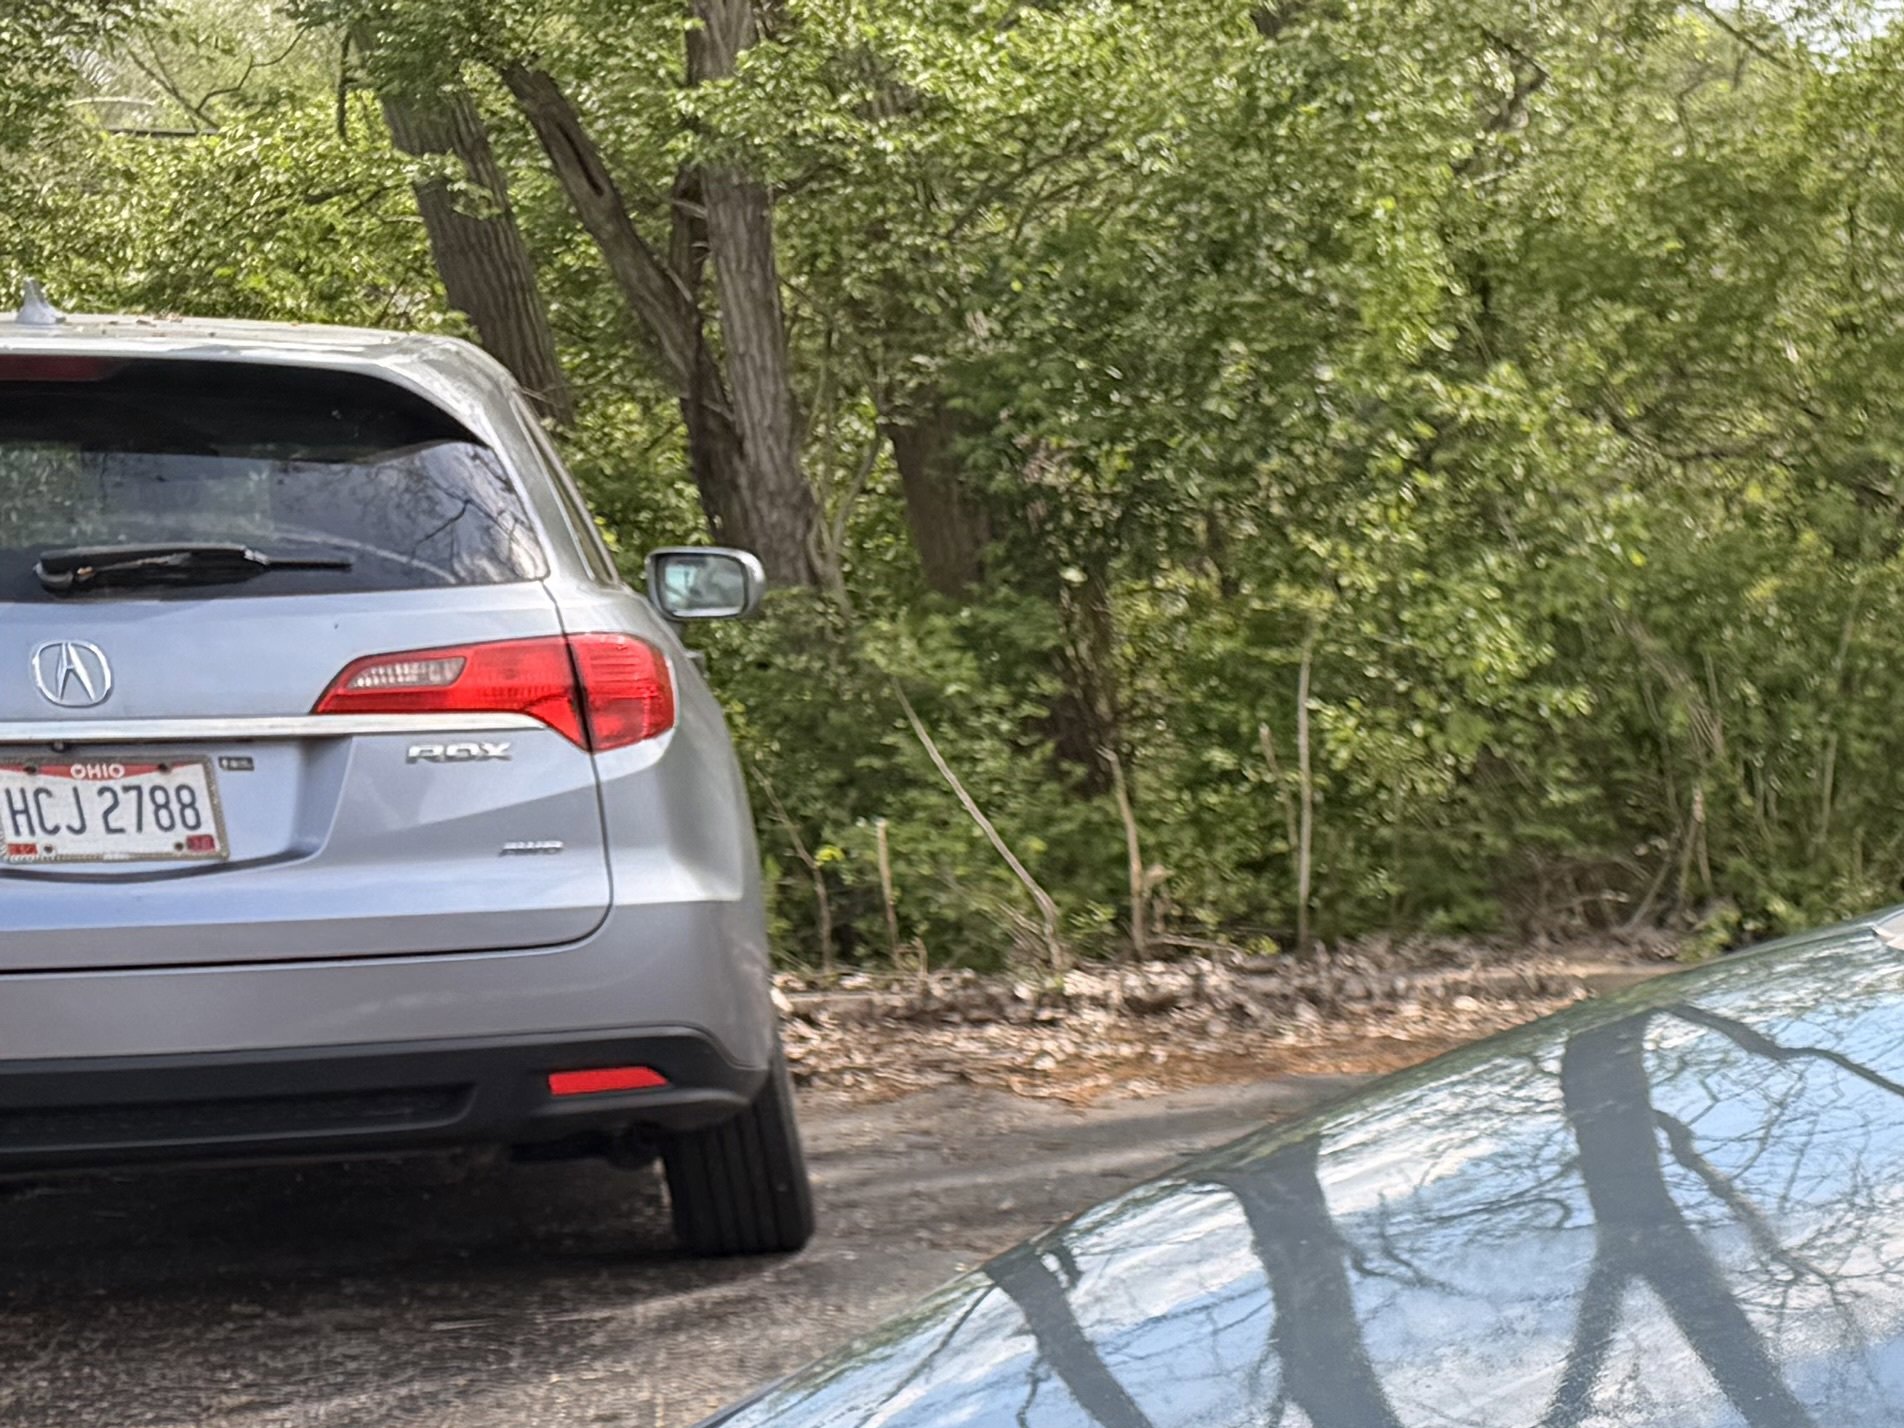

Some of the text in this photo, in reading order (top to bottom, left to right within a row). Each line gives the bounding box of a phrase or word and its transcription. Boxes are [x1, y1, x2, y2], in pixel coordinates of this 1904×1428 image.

[405, 742, 512, 764] RDX
[70, 763, 125, 779] OHIO
[4, 784, 202, 837] HCJ 2788
